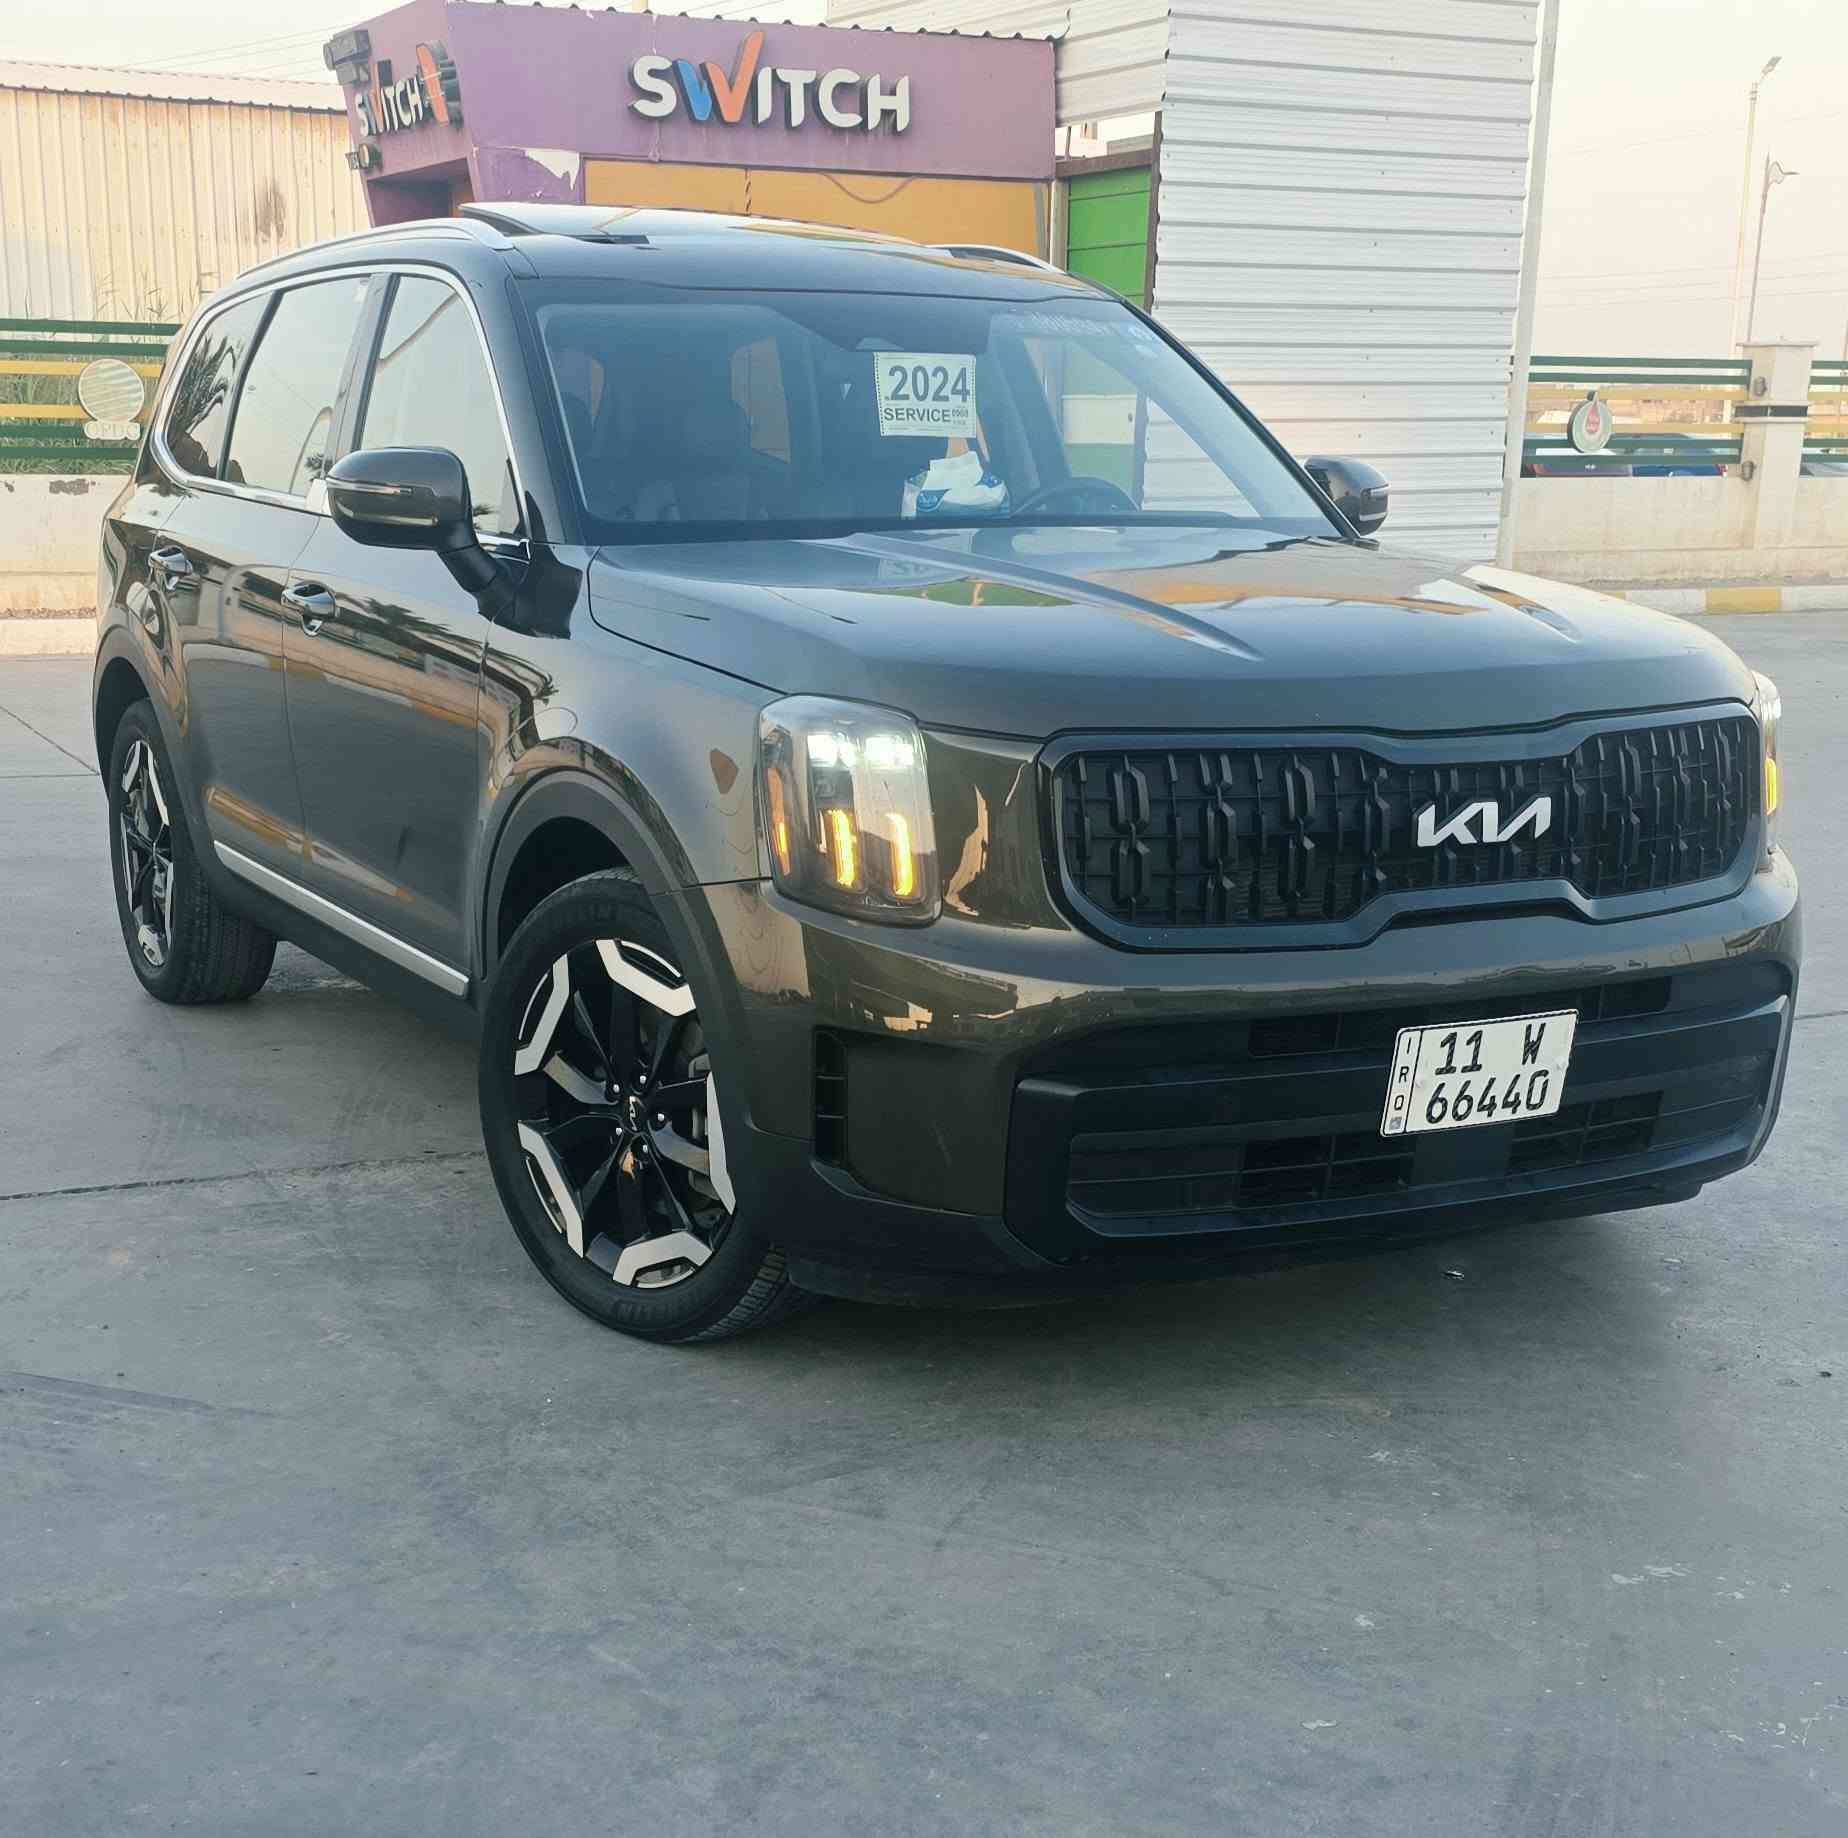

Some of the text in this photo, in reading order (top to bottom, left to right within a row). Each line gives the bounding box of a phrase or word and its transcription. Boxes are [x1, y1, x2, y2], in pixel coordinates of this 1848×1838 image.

[354, 62, 424, 136] SWITCH
[630, 31, 911, 133] SWITCH
[888, 365, 971, 402] 2024
[883, 407, 951, 422] SERVICE
[1416, 796, 1551, 848] KIA
[1435, 1022, 1547, 1076] 11 W
[1426, 1069, 1550, 1125] 66440
